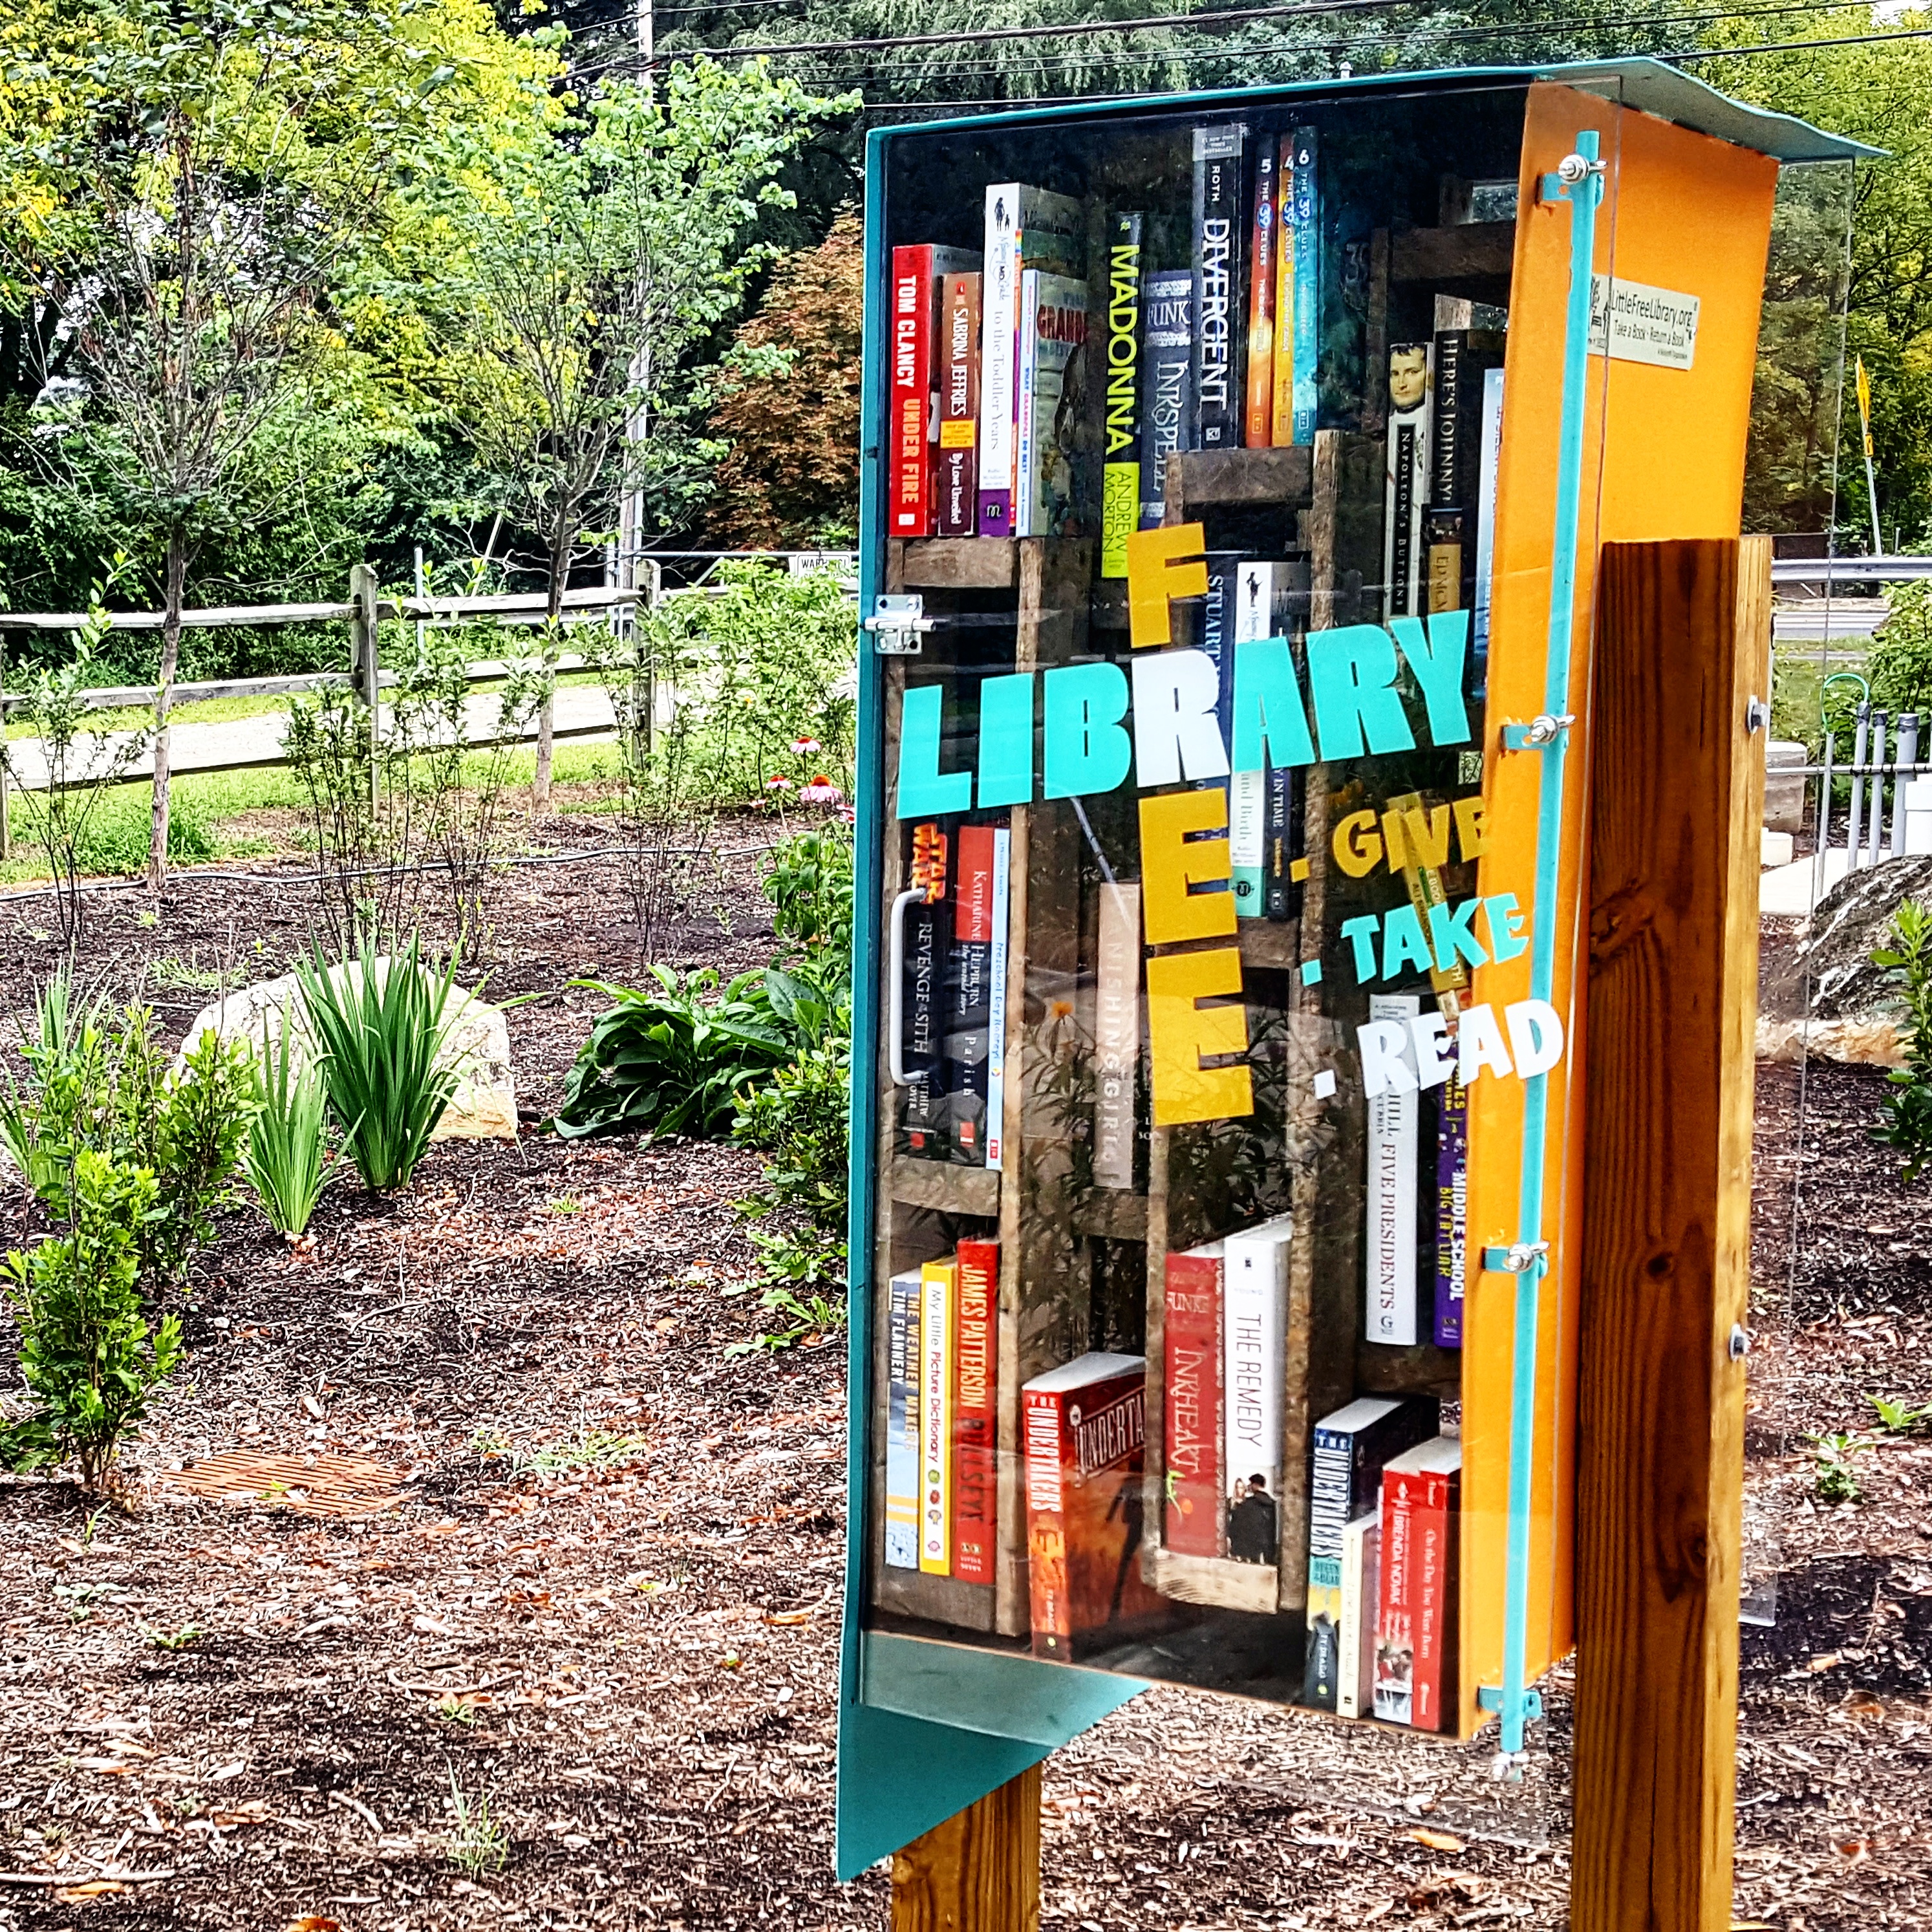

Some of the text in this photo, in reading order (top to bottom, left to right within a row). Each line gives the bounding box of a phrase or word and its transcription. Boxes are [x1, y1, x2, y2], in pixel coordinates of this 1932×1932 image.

[1210, 165, 1221, 202] ROTH
[1261, 158, 1272, 173] 5
[1298, 149, 1310, 165] 6
[1300, 173, 1309, 193] THE
[1260, 180, 1269, 202] THE
[1260, 230, 1269, 266] CLUES
[896, 275, 917, 389] TOM CLANCY
[952, 308, 969, 361] SABRINA
[993, 330, 1005, 352] the
[1201, 219, 1230, 411] DIVERGENT
[1611, 289, 1693, 332] LittleFreeLibrary.org
[1105, 244, 1141, 456] MADONNA
[1441, 338, 1459, 408] HERE'S
[950, 363, 968, 416] JEFFRIES
[992, 354, 1004, 411] Toddler
[903, 398, 921, 458] UNDER
[991, 413, 1004, 450] Years
[901, 463, 919, 504] FIRE
[1102, 473, 1115, 552] MORTON
[1115, 472, 1132, 553] ANDREW
[1395, 433, 1411, 606] NAPOLEON'S BUTTONS
[896, 610, 1472, 820] LIBRARY
[1272, 778, 1285, 793] IN
[1272, 793, 1285, 828] TIME
[912, 825, 931, 903] WAR
[1333, 797, 1489, 878] GIVE
[916, 923, 933, 1002] REVENGE
[969, 870, 987, 1007] KATHARINE HEPBURN
[994, 942, 1004, 991] Preschool
[1340, 892, 1529, 985] TAKE
[914, 1013, 929, 1053] SITH
[1357, 998, 1564, 1100] READ
[962, 1036, 977, 1097] Parish
[1380, 1143, 1396, 1310] FIVE PRESIDENTS
[1439, 1186, 1454, 1209] BIG
[1450, 1172, 1466, 1301] MIDDLE SCHOOL
[890, 1291, 906, 1385] TIM FLANNERY
[905, 1324, 920, 1391] WEATHER
[960, 1263, 988, 1408] JAMES PATTERSON
[1236, 1313, 1261, 1353] THE
[927, 1289, 942, 1463] My Little Picture Dictionary
[1029, 1396, 1057, 1408] THE
[1236, 1360, 1263, 1448] REMEDY
[1078, 1391, 1147, 1477] UNDERTA
[1169, 1347, 1213, 1474] INKHEART
[1318, 1435, 1348, 1450] THE
[1027, 1407, 1064, 1512] UNDERTAKERS
[1310, 1448, 1349, 1560] UNDERTAKERS
[1391, 1516, 1406, 1562] BRENDA
[1390, 1564, 1402, 1605] NOVAK
